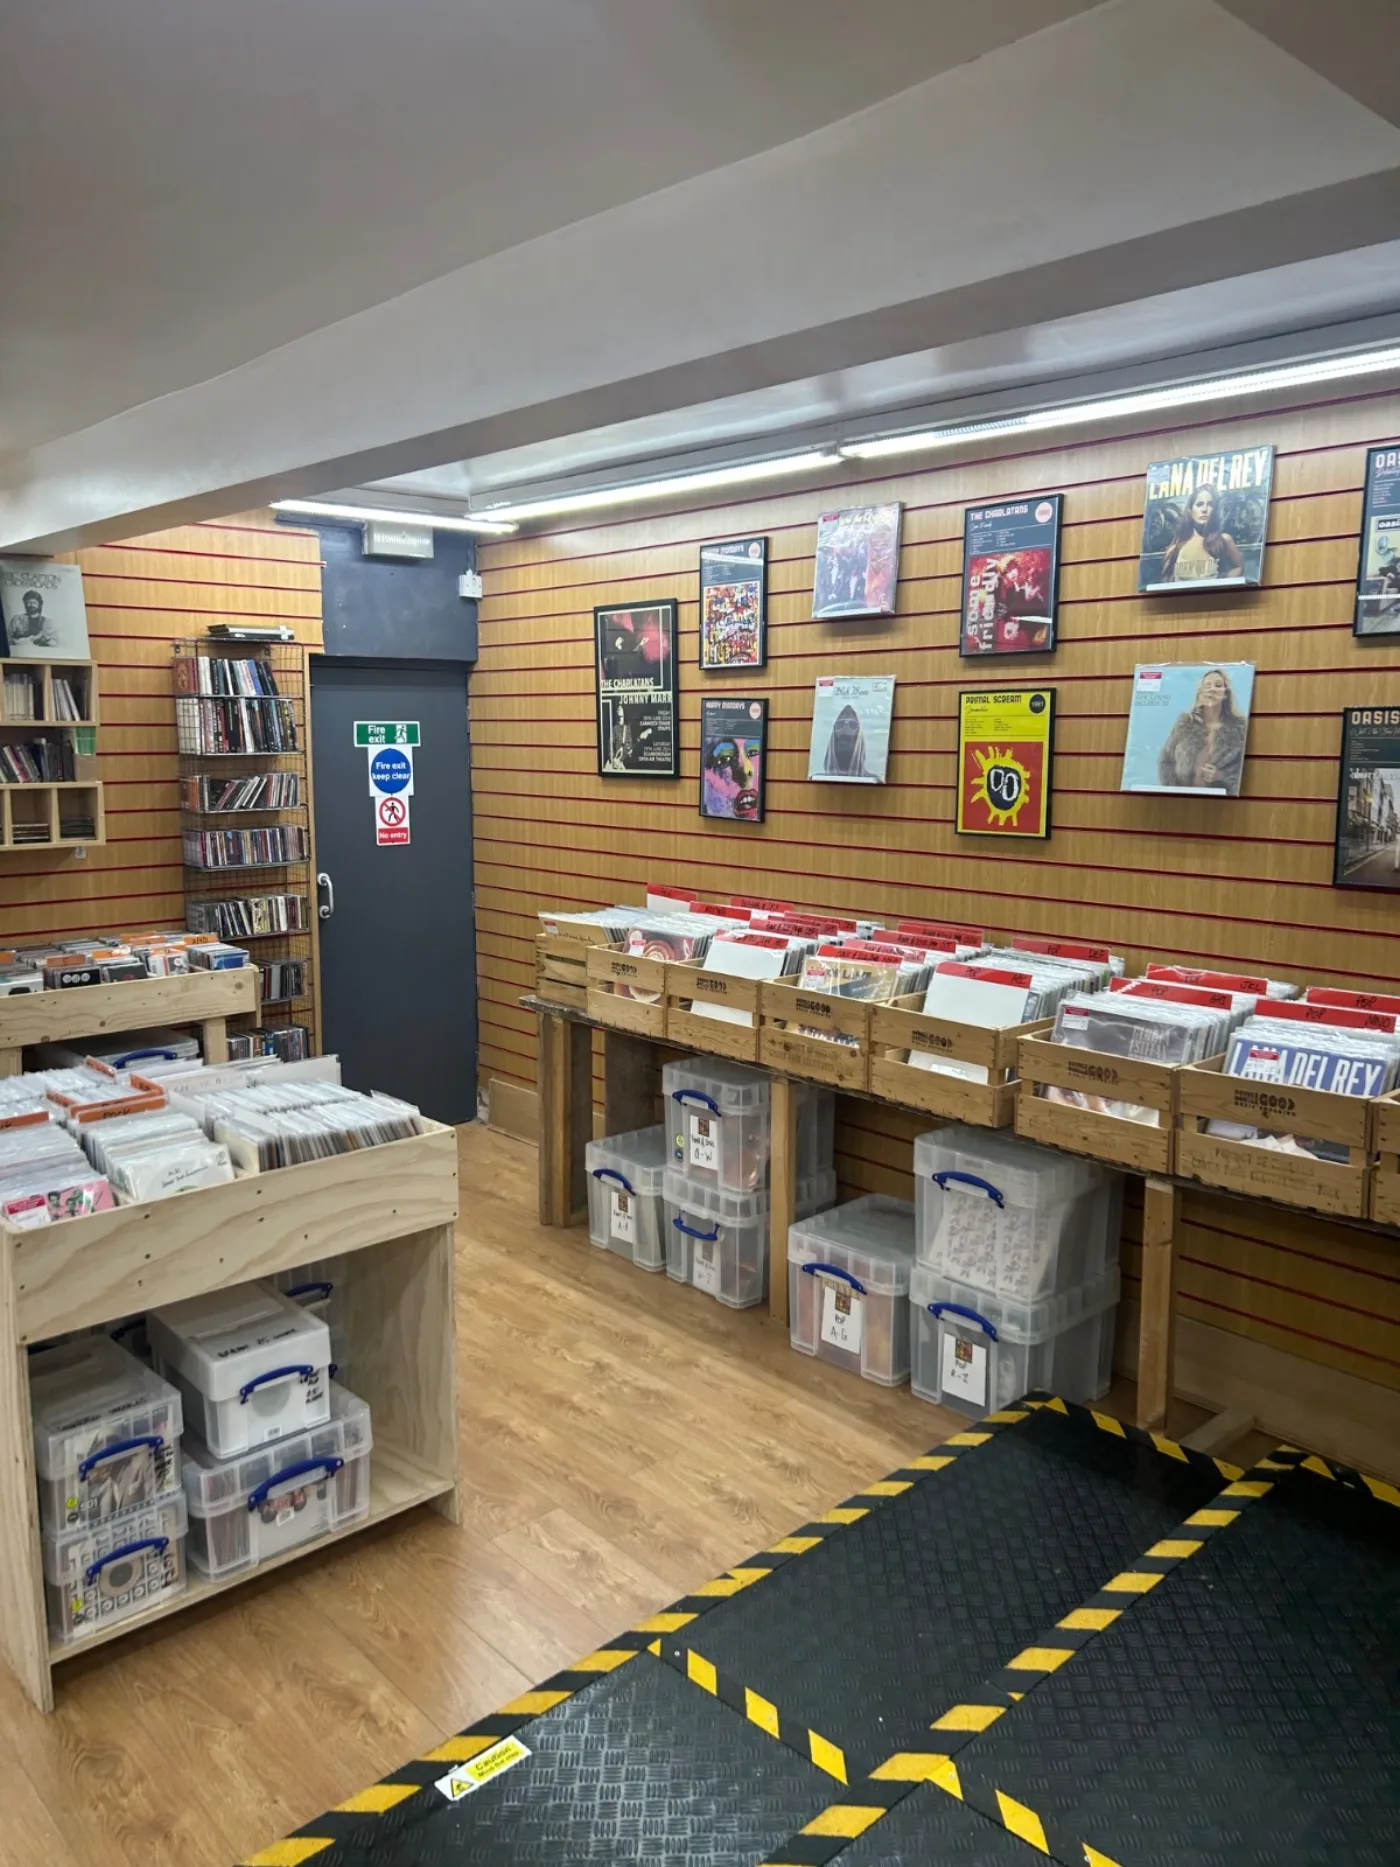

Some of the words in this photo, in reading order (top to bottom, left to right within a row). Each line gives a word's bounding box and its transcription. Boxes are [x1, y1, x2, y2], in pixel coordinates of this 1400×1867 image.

[1375, 452, 1400, 469] OA
[1229, 450, 1269, 489] REY
[971, 511, 983, 520] THE
[985, 504, 1028, 519] CHARLATANS
[968, 575, 980, 635] some
[601, 680, 613, 688] THE
[614, 677, 654, 688] CHARLATANS
[619, 693, 650, 704] JOHNNY
[651, 693, 672, 704] MARR
[965, 695, 991, 704] PRIMAL
[993, 695, 1021, 704] SCREAM
[1351, 710, 1400, 725] OASIS
[368, 725, 386, 734] Fire
[368, 735, 386, 743] exit
[375, 762, 391, 770] Fire
[392, 762, 406, 770] exit
[372, 772, 391, 781] keep
[392, 772, 410, 780] clear
[390, 832, 407, 840] entry
[1355, 995, 1378, 1008] POP
[1305, 1008, 1327, 1020] POP
[1288, 1052, 1329, 1092] DEL
[1330, 1059, 1383, 1098] REY
[1259, 1092, 1295, 1111] GOOD
[834, 1313, 846, 1325] POP
[955, 1359, 968, 1369] POP
[475, 1746, 511, 1771] Caution
